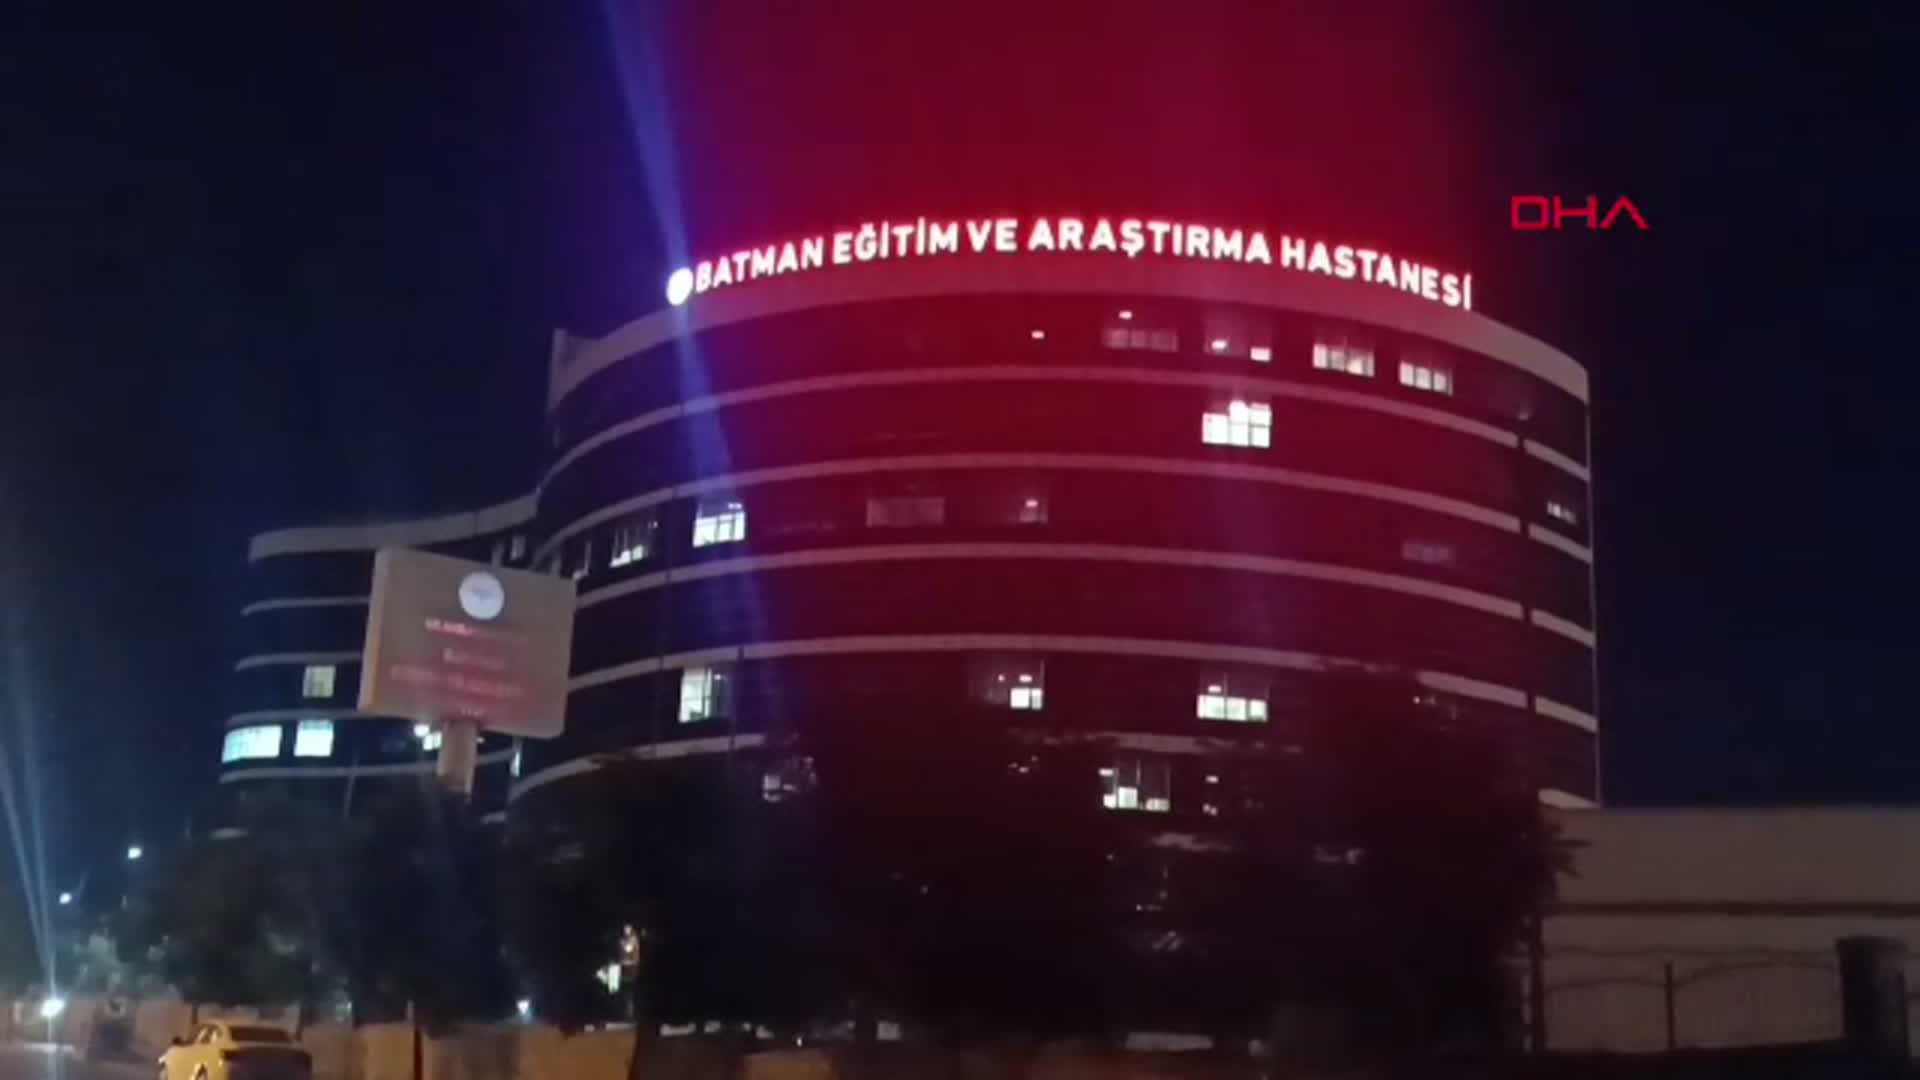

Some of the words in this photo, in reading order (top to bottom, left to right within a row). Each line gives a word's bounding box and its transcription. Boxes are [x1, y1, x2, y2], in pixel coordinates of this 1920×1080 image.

[694, 236, 824, 293] BATMAN
[832, 217, 959, 265] EĞİTİM
[967, 218, 1018, 252] VE
[1028, 217, 1272, 264] ARAŞTIRMA
[1280, 234, 1472, 310] HASTANESİ
